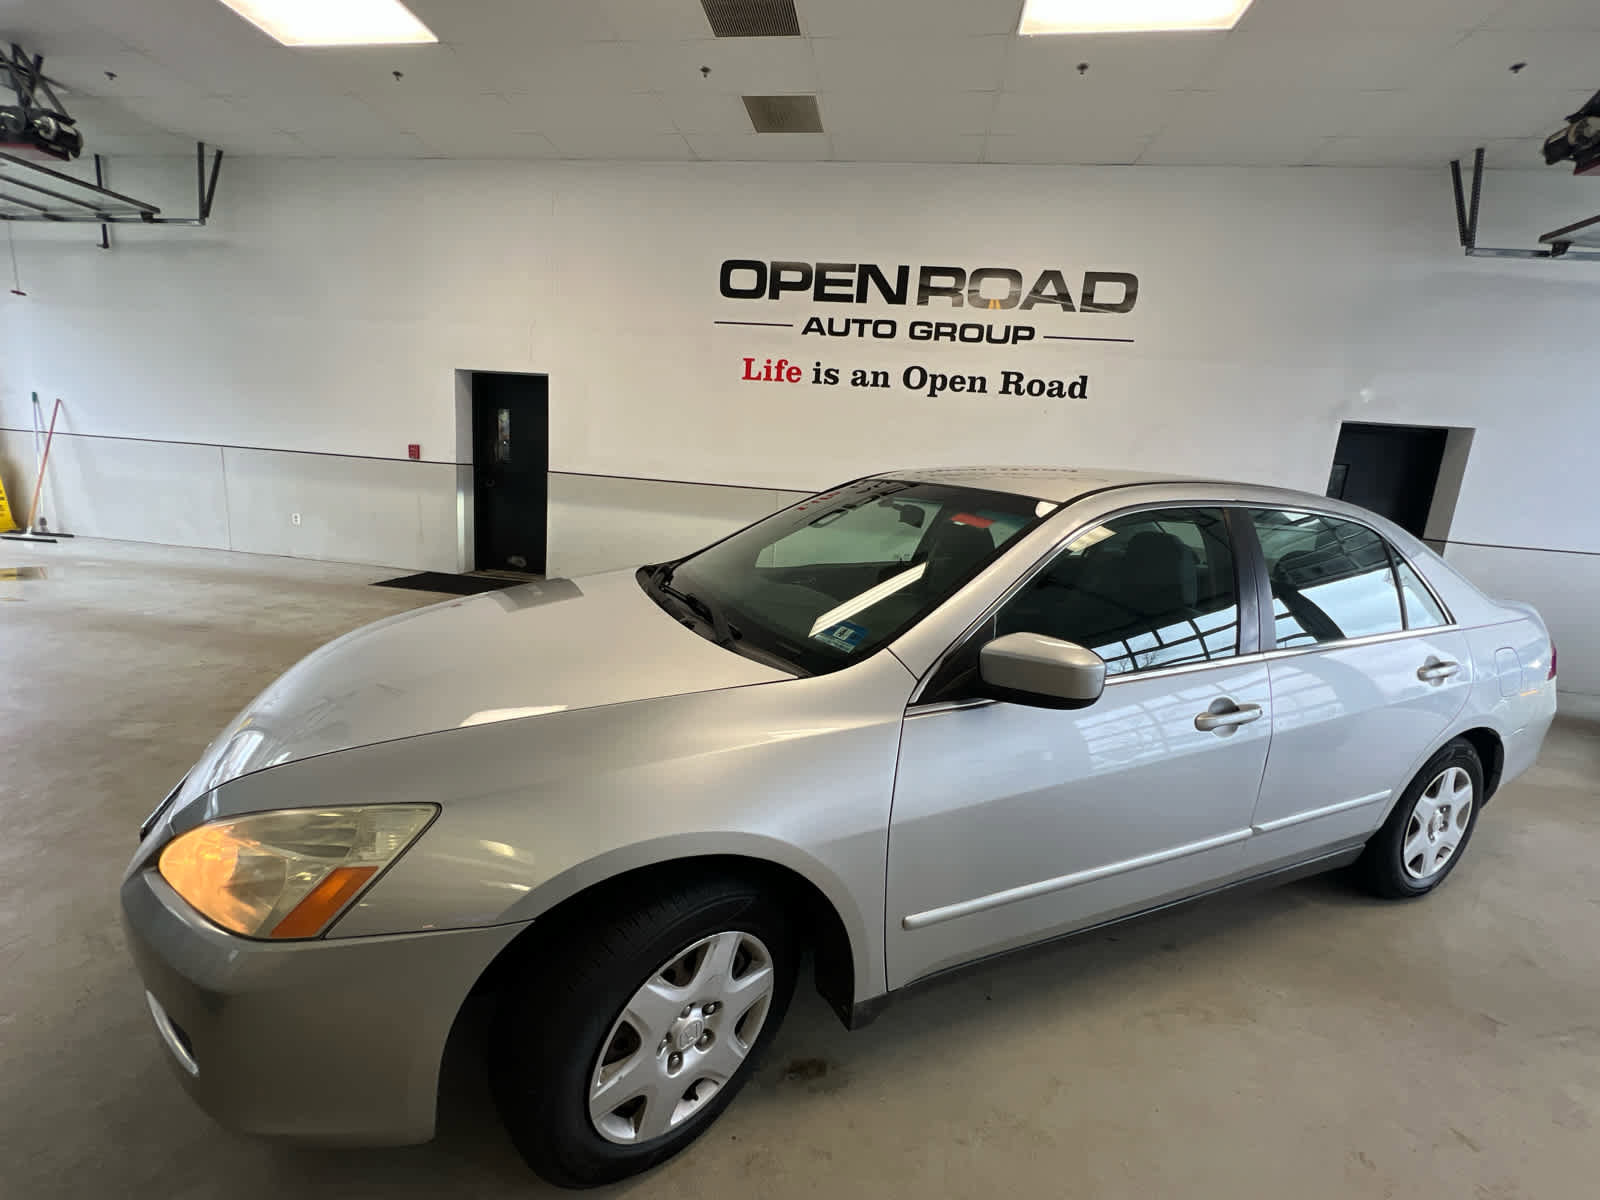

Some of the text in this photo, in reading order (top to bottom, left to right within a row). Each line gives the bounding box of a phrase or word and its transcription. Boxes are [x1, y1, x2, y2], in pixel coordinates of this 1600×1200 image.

[800, 316, 1036, 345] AUTO GROUP
[742, 357, 1089, 400] Life is an Open Road
